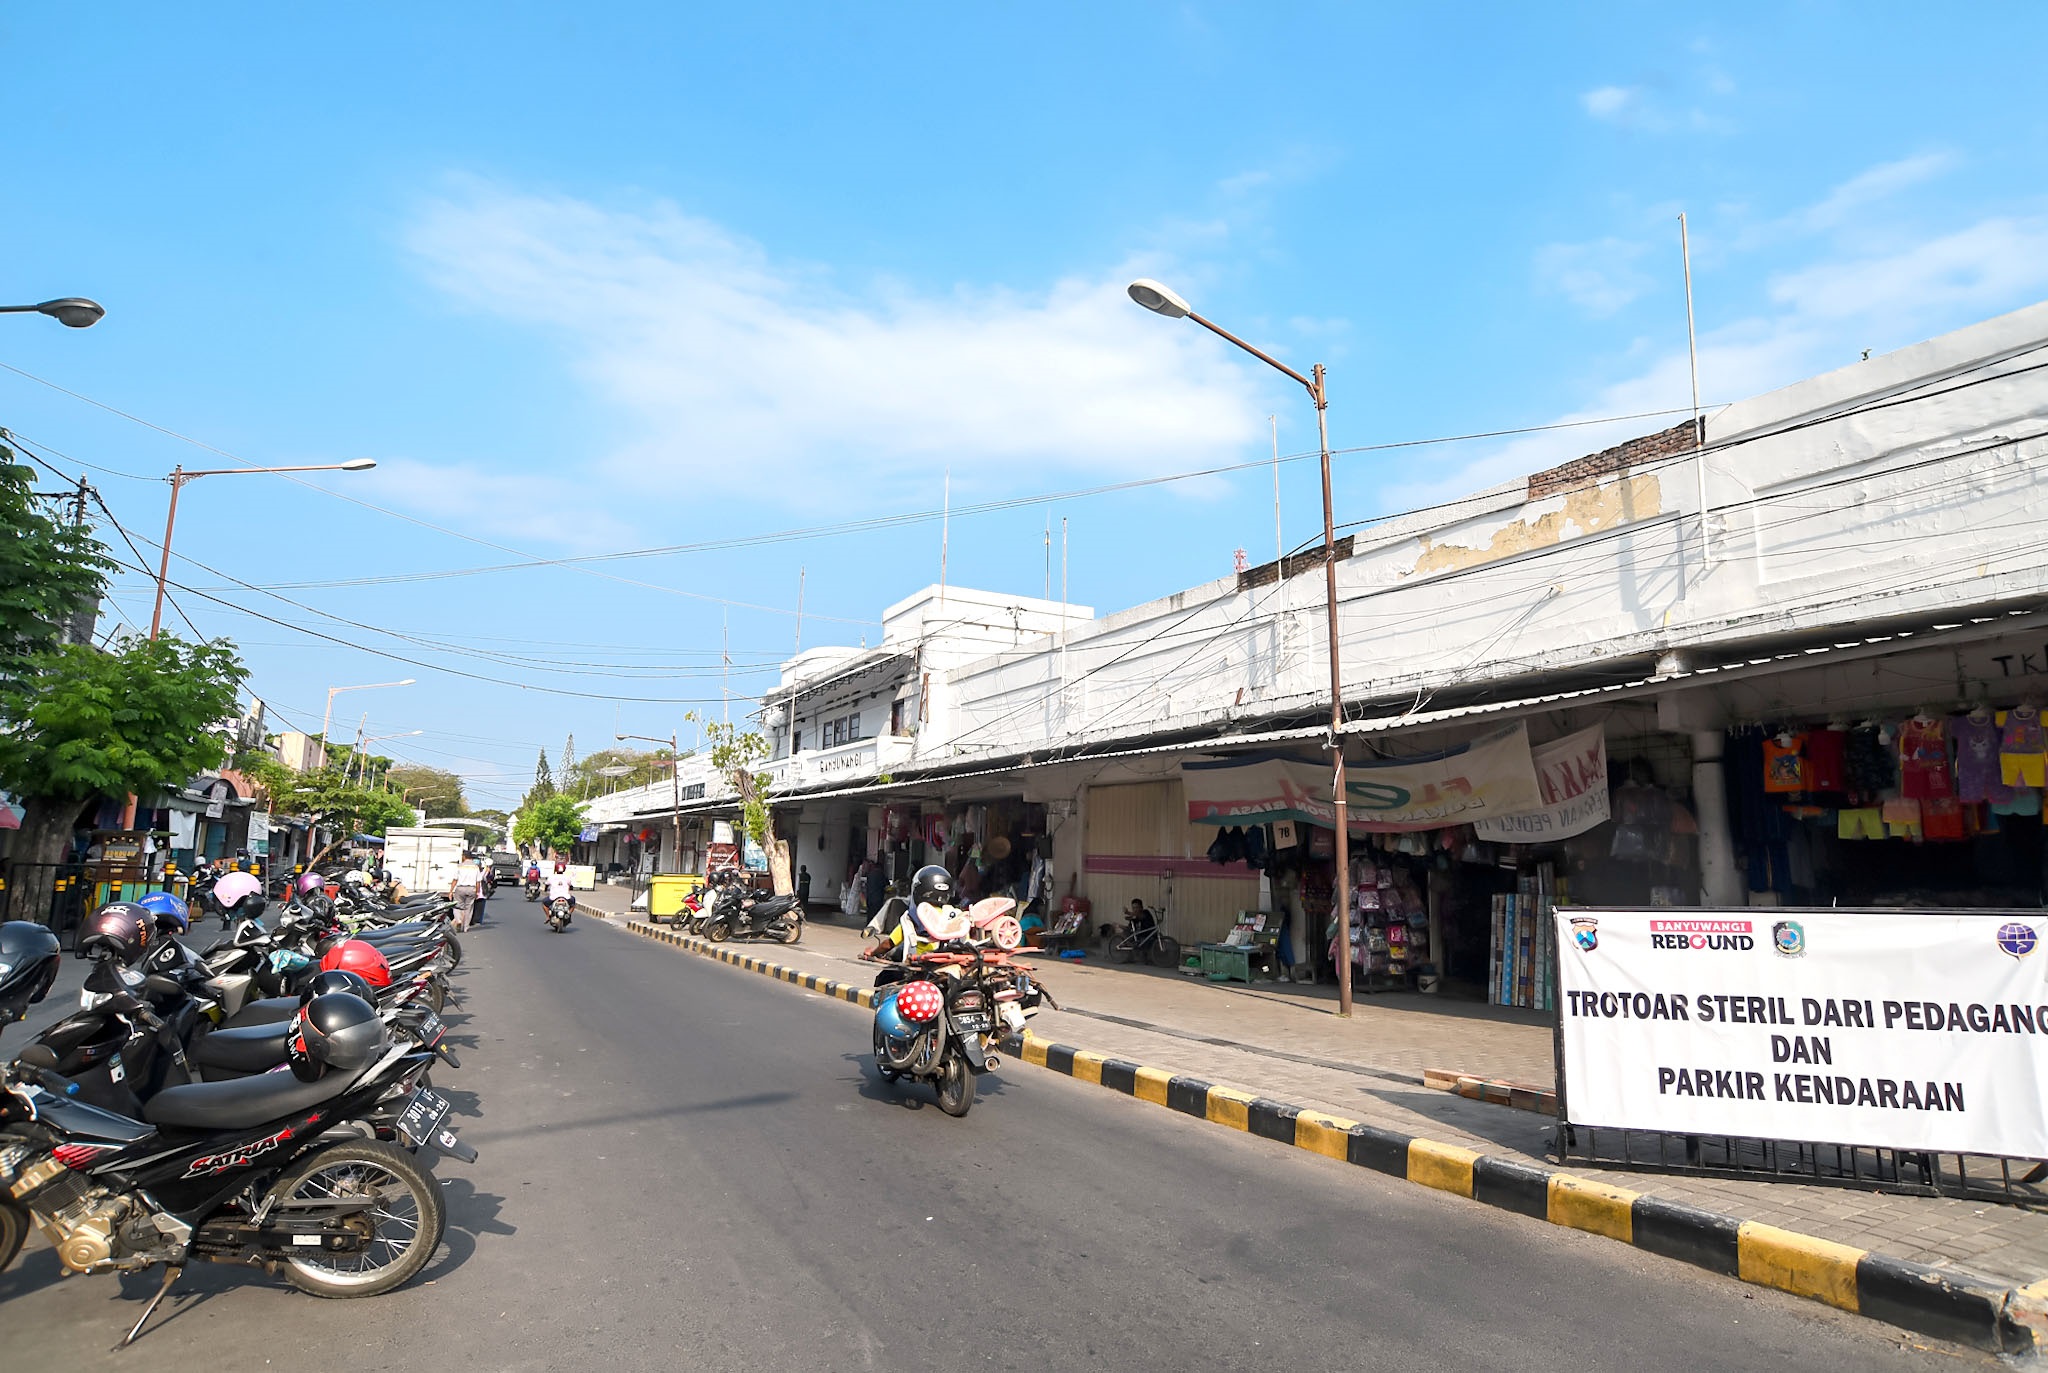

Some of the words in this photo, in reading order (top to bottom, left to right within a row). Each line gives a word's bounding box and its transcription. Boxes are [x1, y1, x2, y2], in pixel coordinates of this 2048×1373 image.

[1657, 920, 1746, 932] BANYUWANGI
[1651, 933, 1754, 951] REBOUND
[1567, 989, 1689, 1021] TROTOAR
[1697, 994, 1796, 1025] STERIL
[1803, 998, 1875, 1028] DARI
[1771, 1034, 1832, 1065] DAN
[1658, 1066, 1765, 1100] PARKIR
[1774, 1073, 1966, 1112] KENDARAAN
[406, 1101, 426, 1123] 3013
[186, 1135, 280, 1177] SATRIA
